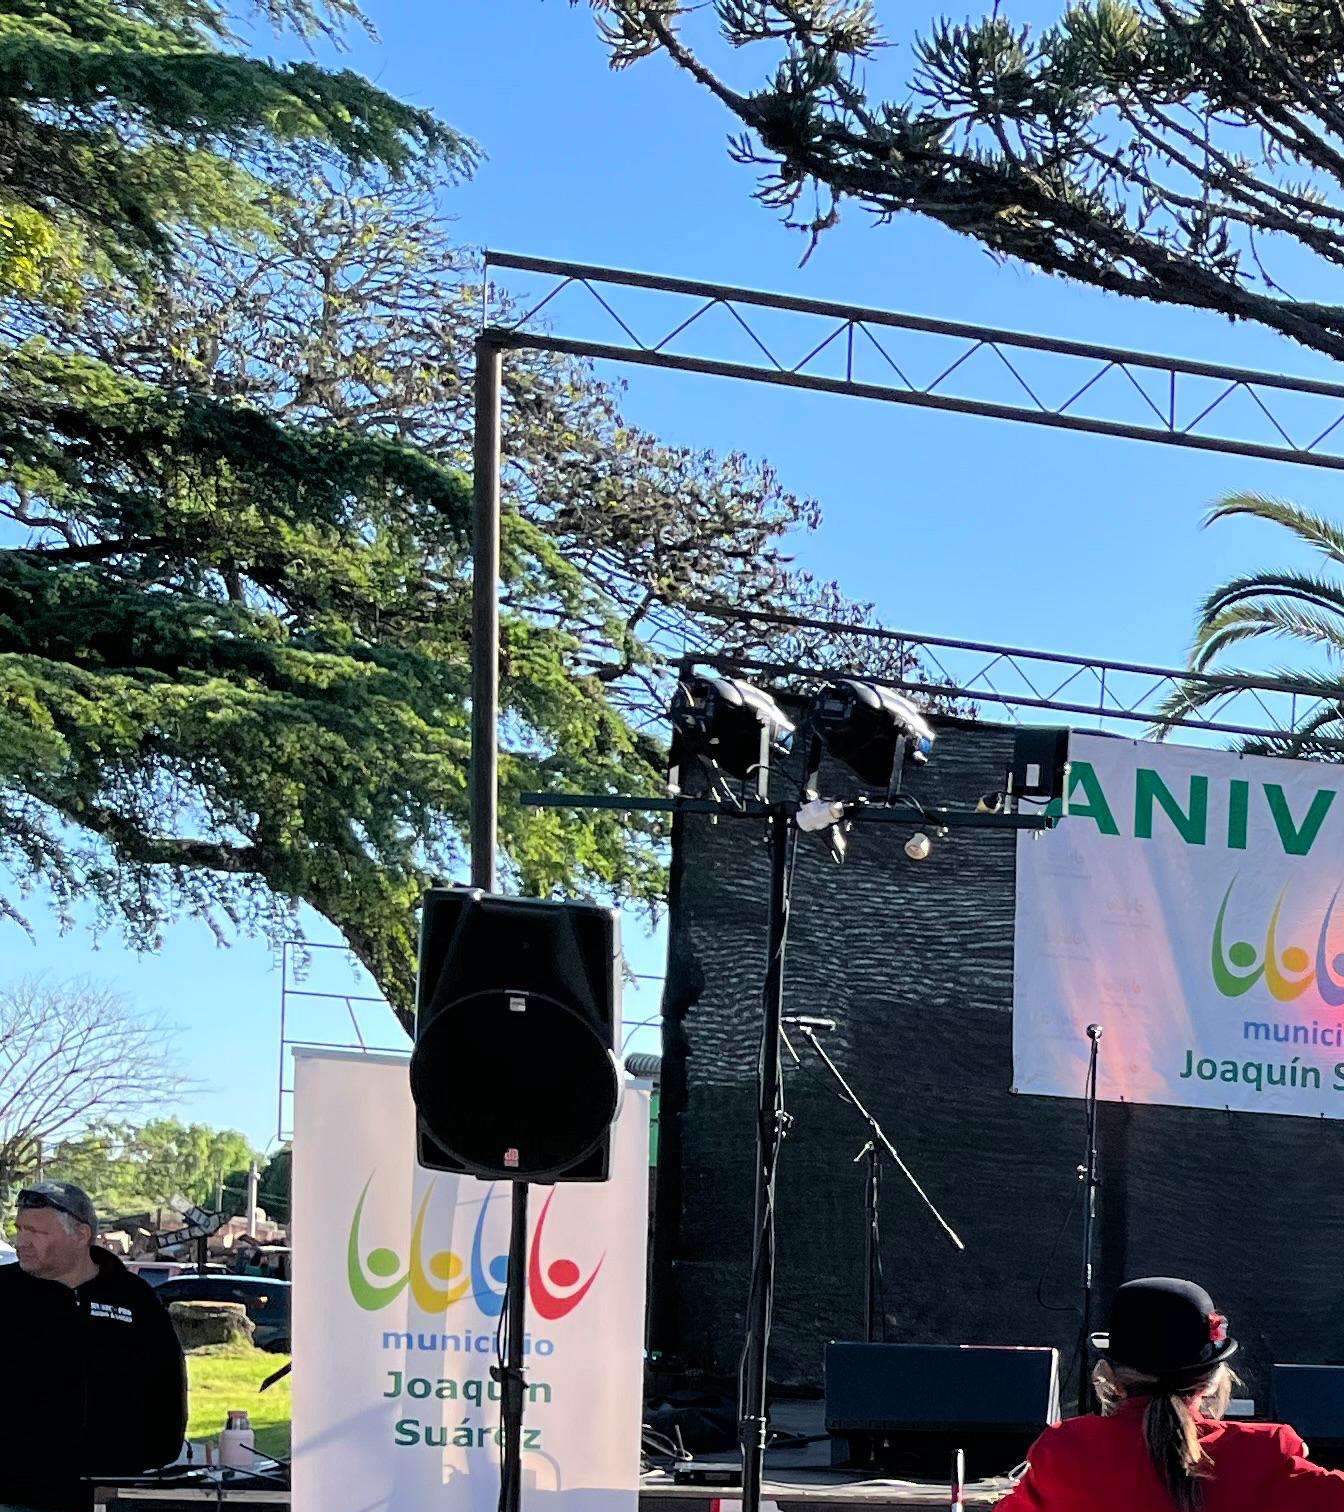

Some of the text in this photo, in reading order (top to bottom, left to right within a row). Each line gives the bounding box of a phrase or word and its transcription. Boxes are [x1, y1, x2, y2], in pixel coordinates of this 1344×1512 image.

[1179, 1049, 1321, 1092] Joaquín
[382, 1329, 555, 1360] municiio
[383, 1370, 552, 1407] Joaqun
